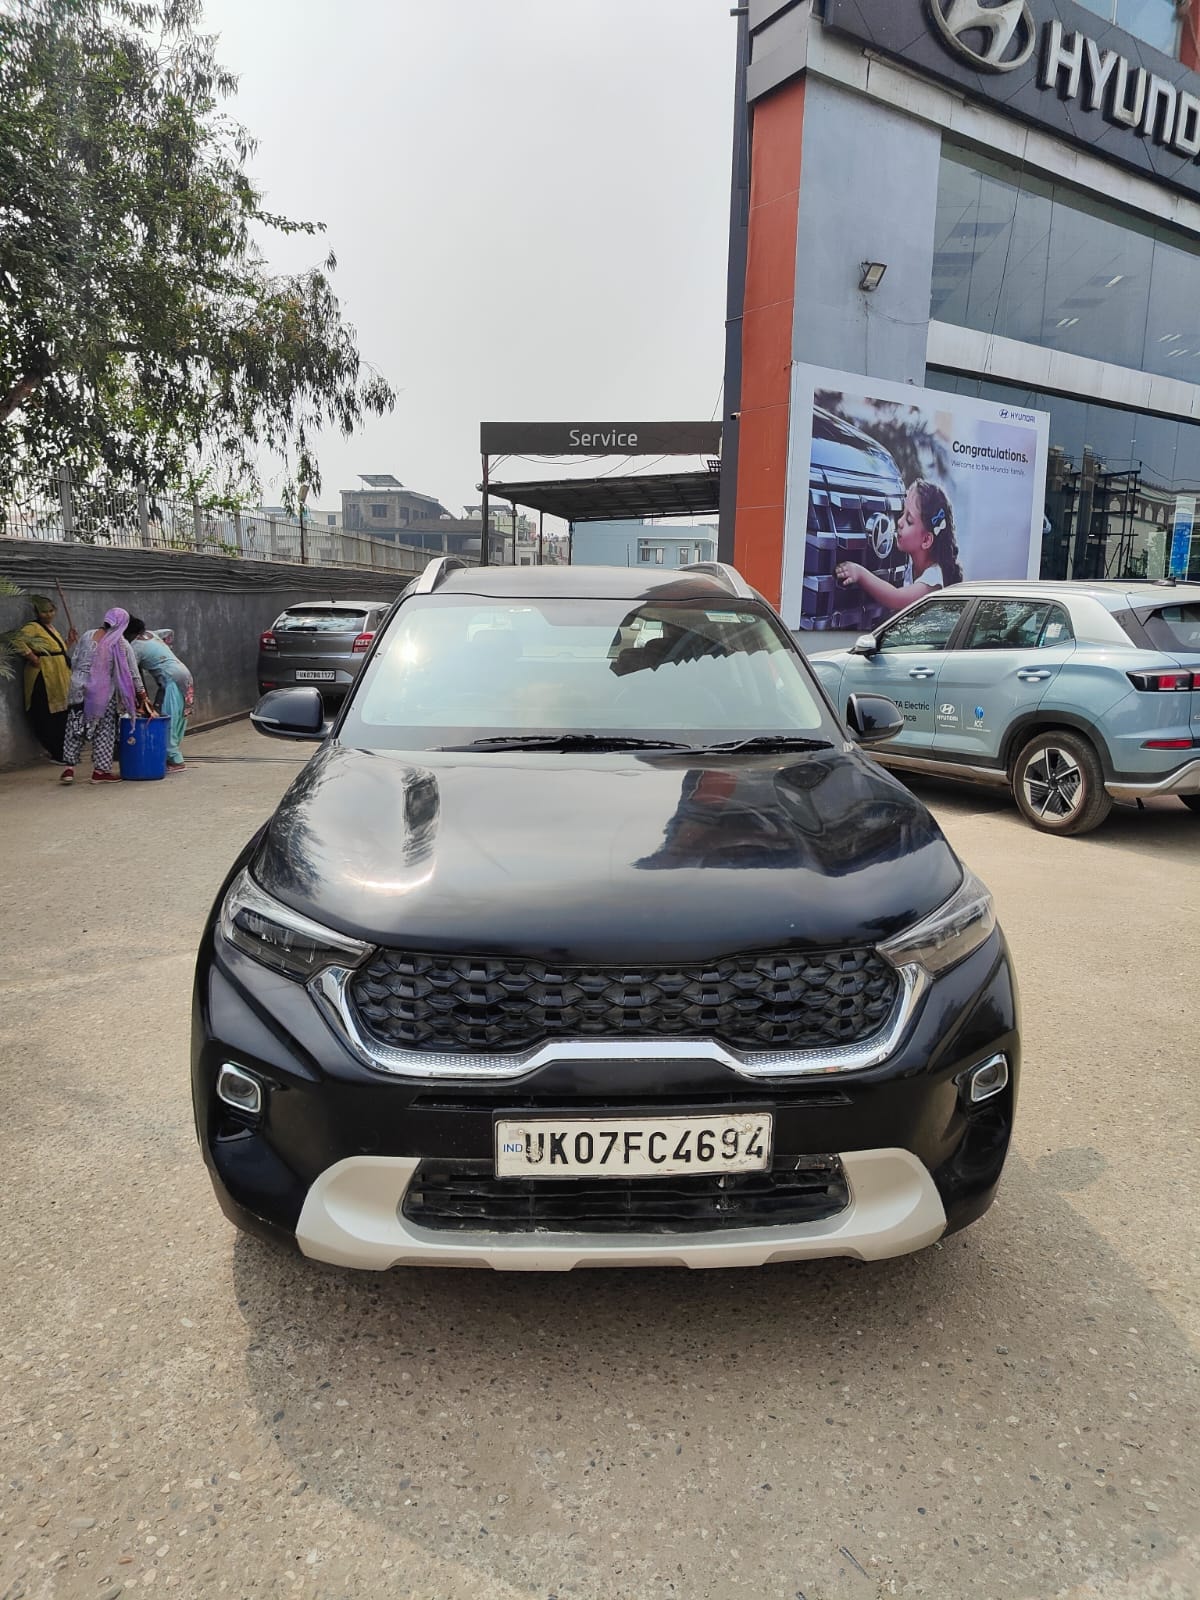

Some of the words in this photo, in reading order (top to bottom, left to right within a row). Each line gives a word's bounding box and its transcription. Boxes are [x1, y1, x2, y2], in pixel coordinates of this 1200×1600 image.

[1010, 412, 1036, 424] HYUNDAI
[568, 429, 638, 447] Service
[952, 440, 1029, 463] Congratulations.
[904, 700, 930, 711] Electric
[503, 1143, 523, 1154] IND
[524, 1126, 765, 1165] UK07FC4694
